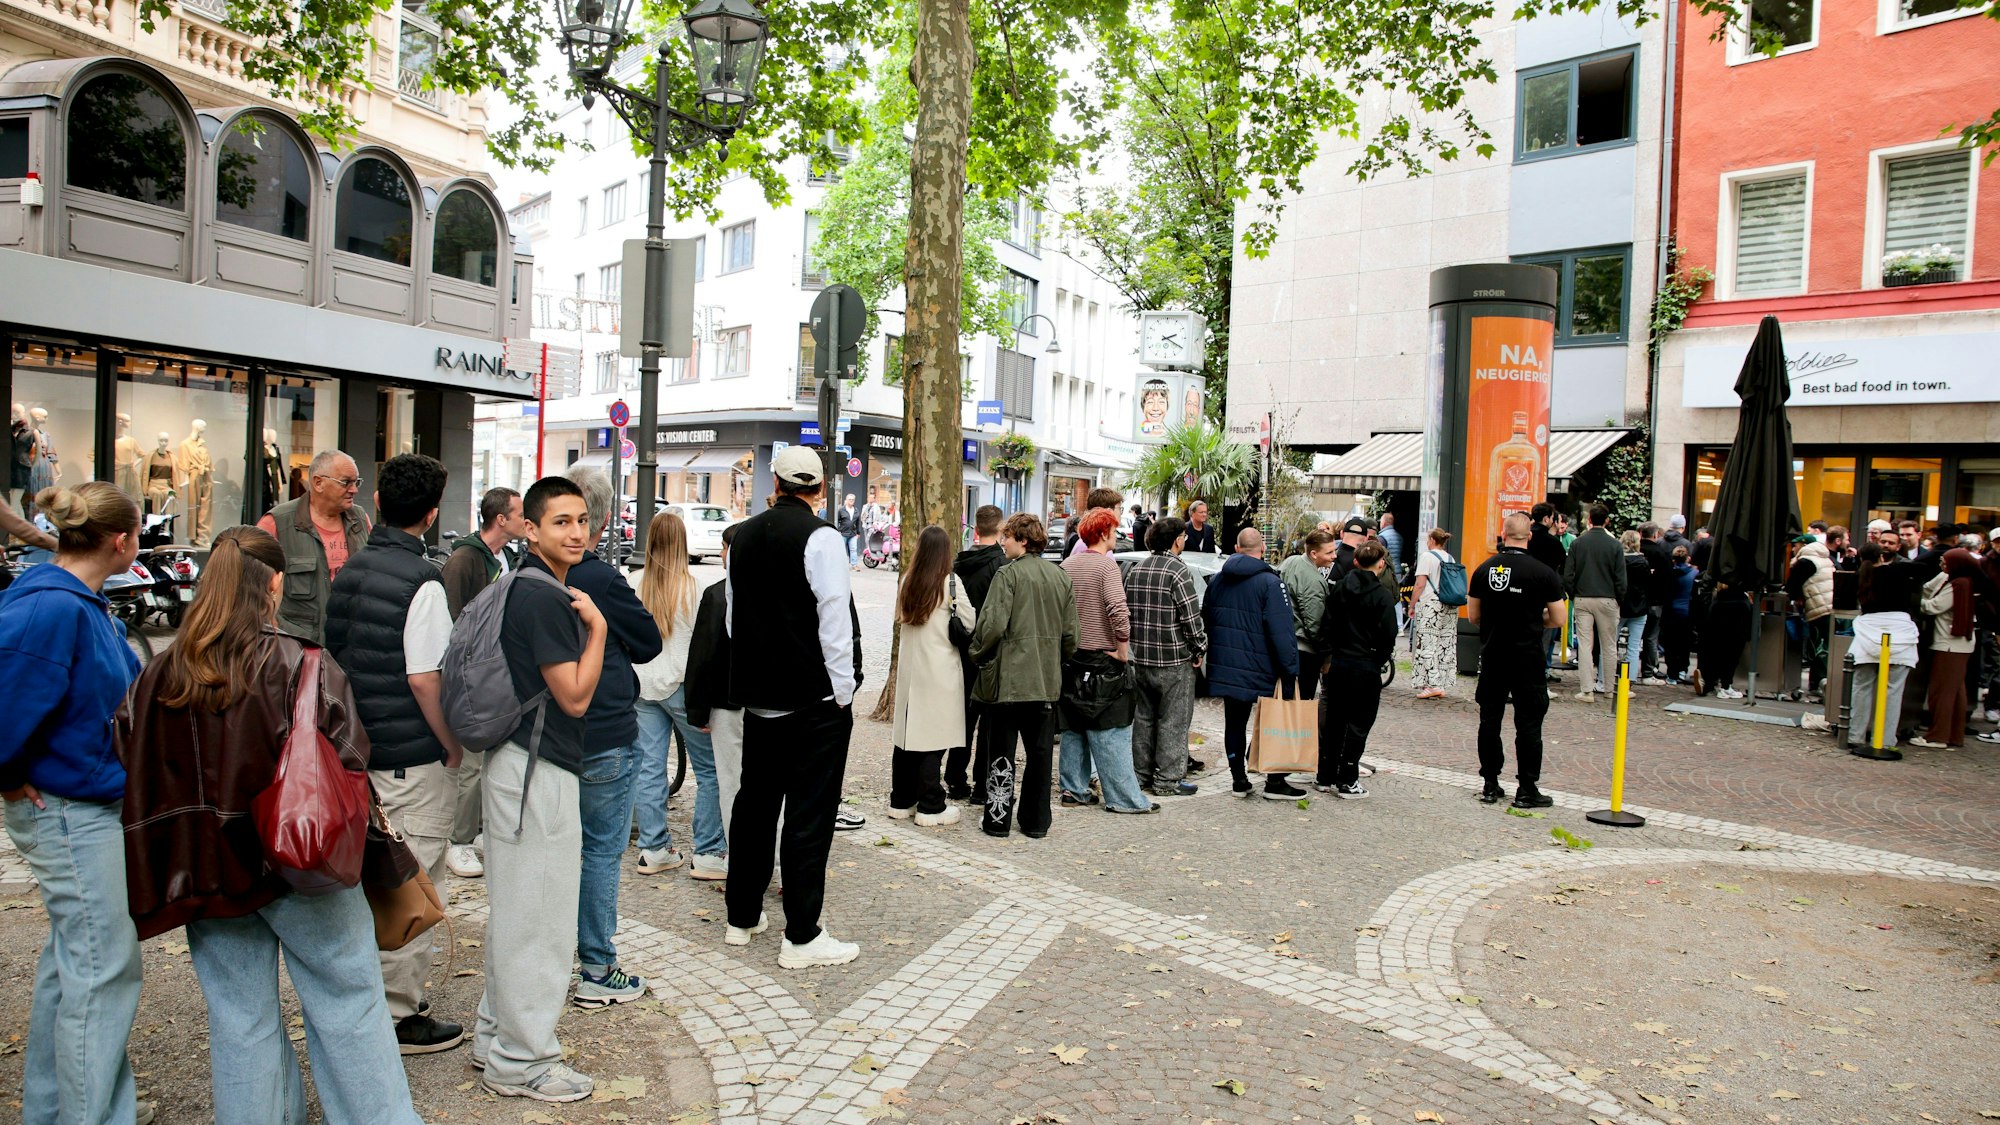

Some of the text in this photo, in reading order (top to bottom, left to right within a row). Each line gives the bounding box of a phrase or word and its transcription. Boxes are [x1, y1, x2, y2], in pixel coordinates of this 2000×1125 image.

[1473, 289, 1506, 297] STRÖER
[1500, 344, 1543, 369] NA,
[1803, 380, 1951, 394] Best bad food in town.
[665, 430, 688, 444] VISION
[689, 429, 717, 442] CENTER
[870, 434, 894, 449] ZEISS
